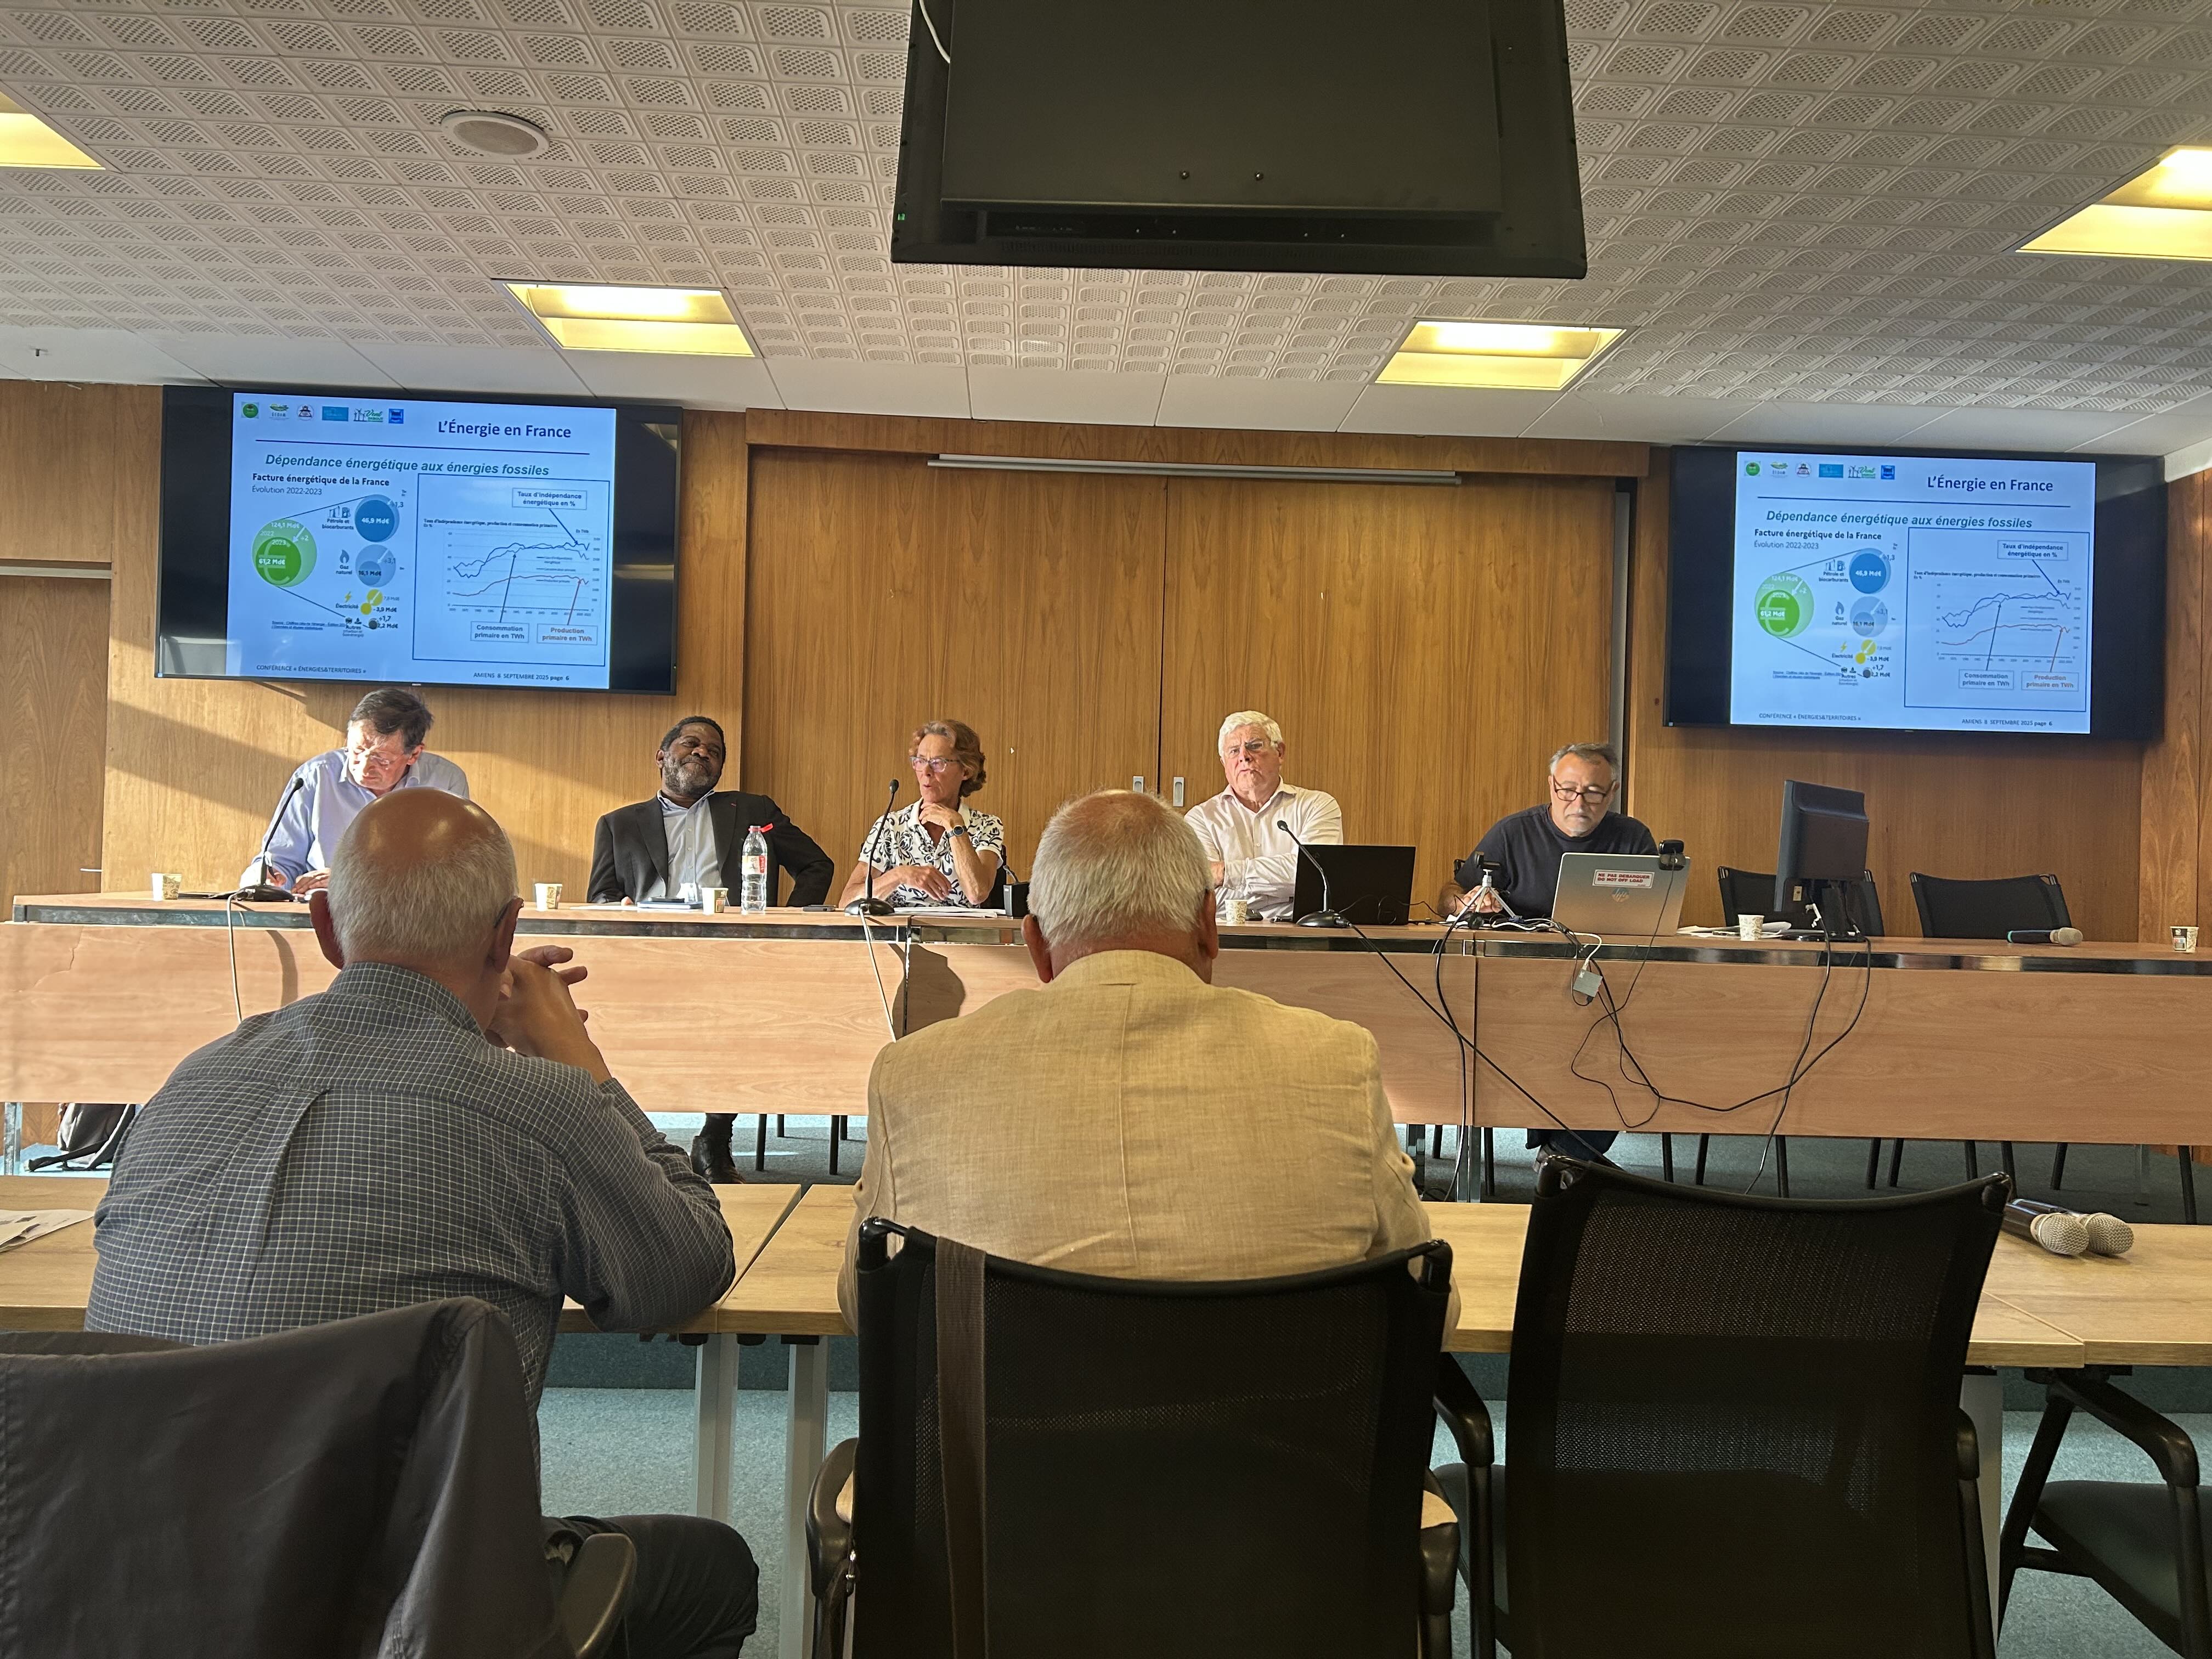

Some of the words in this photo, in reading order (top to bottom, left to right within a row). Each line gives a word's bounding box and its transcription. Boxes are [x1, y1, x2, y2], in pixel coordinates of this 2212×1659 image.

[438, 419, 500, 437] L’Énergie
[504, 426, 521, 436] en
[526, 425, 571, 438] France
[266, 454, 342, 467] Dépendance
[346, 458, 417, 472] énergétique
[421, 462, 443, 471] aux
[447, 462, 498, 475] énergies
[501, 464, 549, 475] fossiles
[253, 473, 284, 482] Facture
[286, 474, 337, 486] énergétique
[340, 476, 349, 484] de
[352, 477, 359, 485] la
[362, 477, 390, 486] France
[1927, 475, 1986, 492] L’Énergie
[1990, 481, 2006, 489] en
[2010, 479, 2053, 492] France
[1767, 510, 1837, 523] Dépendance
[1841, 513, 1908, 526] énergétique
[1911, 517, 1933, 525] aux
[1936, 516, 1984, 528] énergies
[1988, 517, 2032, 528] fossiles
[1786, 529, 1832, 540] énergétique
[1786, 541, 1819, 549] 2022-2023
[2018, 543, 2063, 551] d'indépendance
